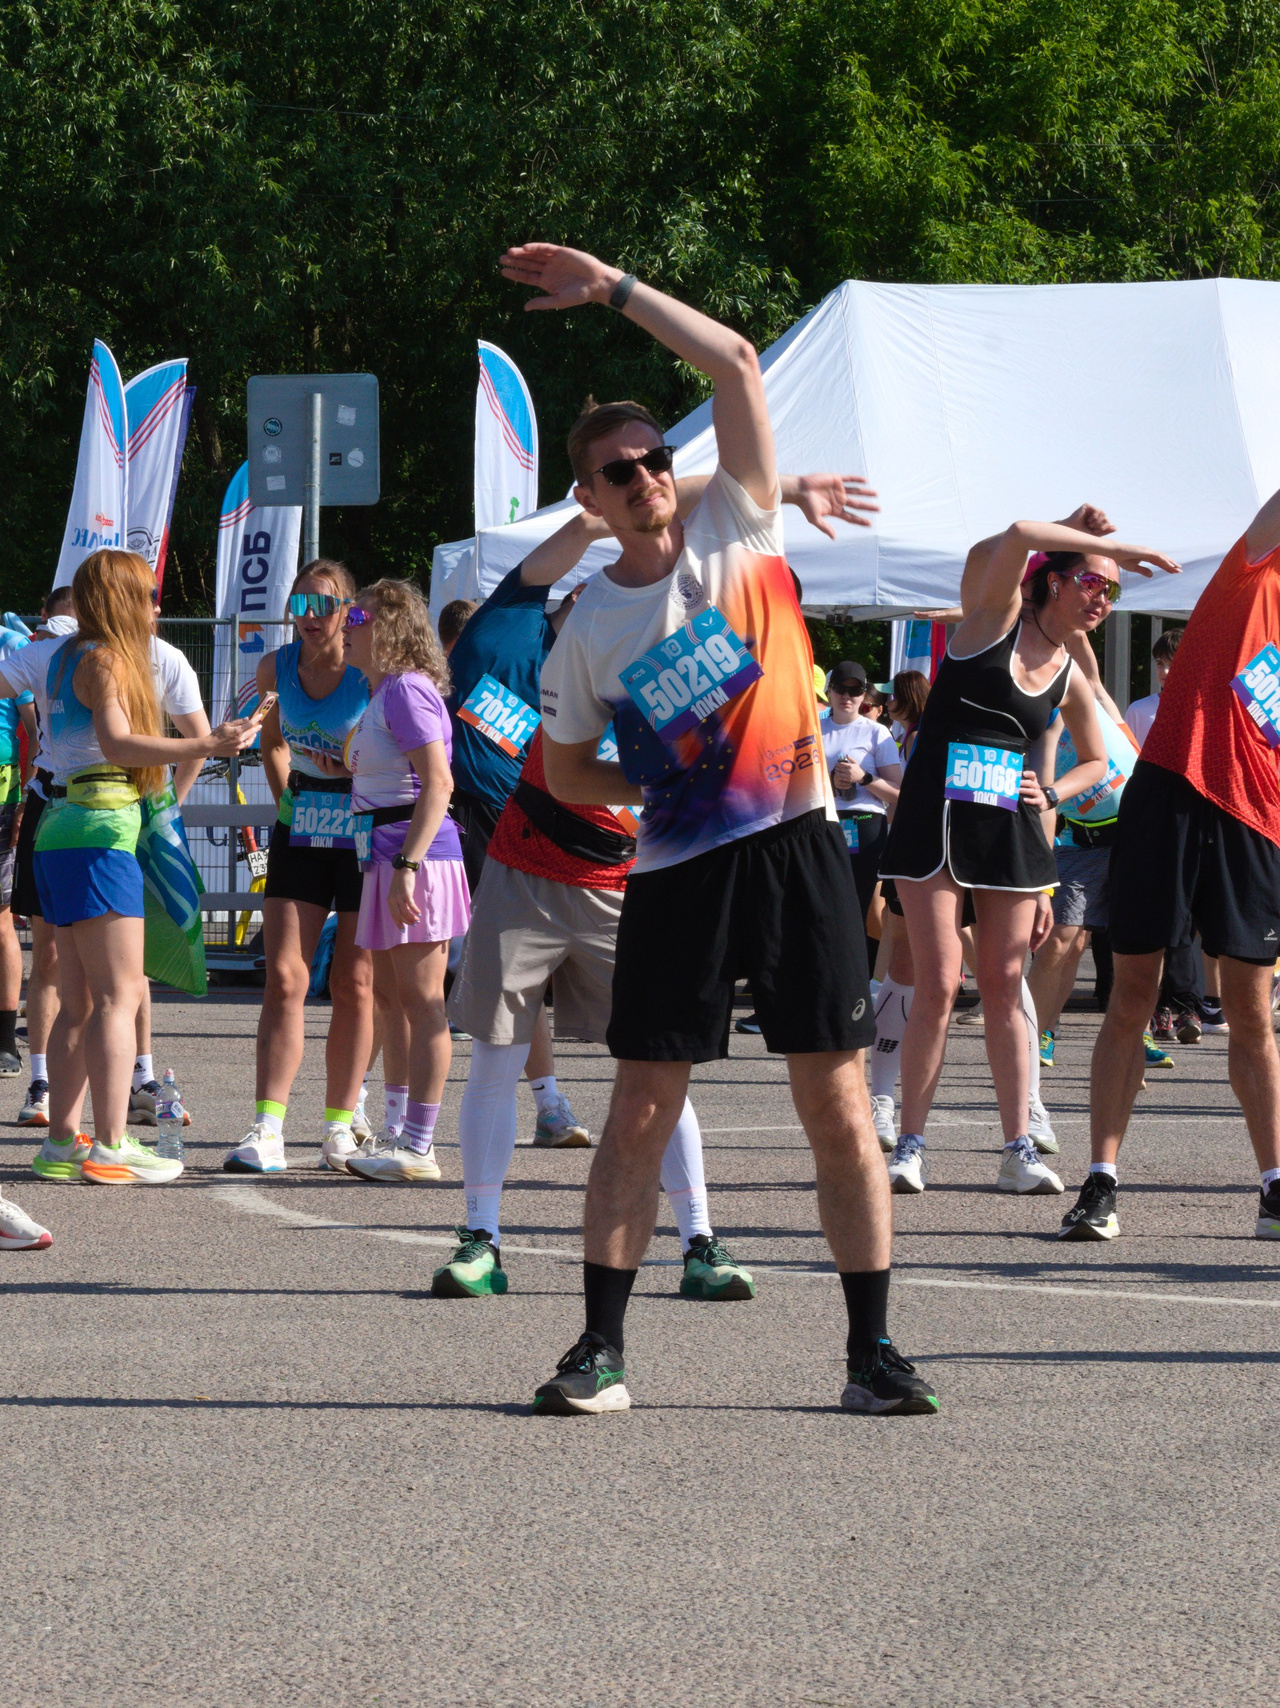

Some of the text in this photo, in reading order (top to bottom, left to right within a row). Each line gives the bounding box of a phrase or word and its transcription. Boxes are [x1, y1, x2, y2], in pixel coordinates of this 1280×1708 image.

[241, 531, 271, 612] ПСБ
[639, 633, 741, 721] 50219
[473, 690, 528, 742] 70141
[690, 685, 730, 721] 10KM
[1246, 699, 1269, 728] 10KM
[765, 749, 820, 781] 2026
[952, 759, 1017, 796] 50168
[973, 790, 998, 806] 10KM
[294, 806, 354, 836] 50227
[310, 835, 333, 849] 10KM
